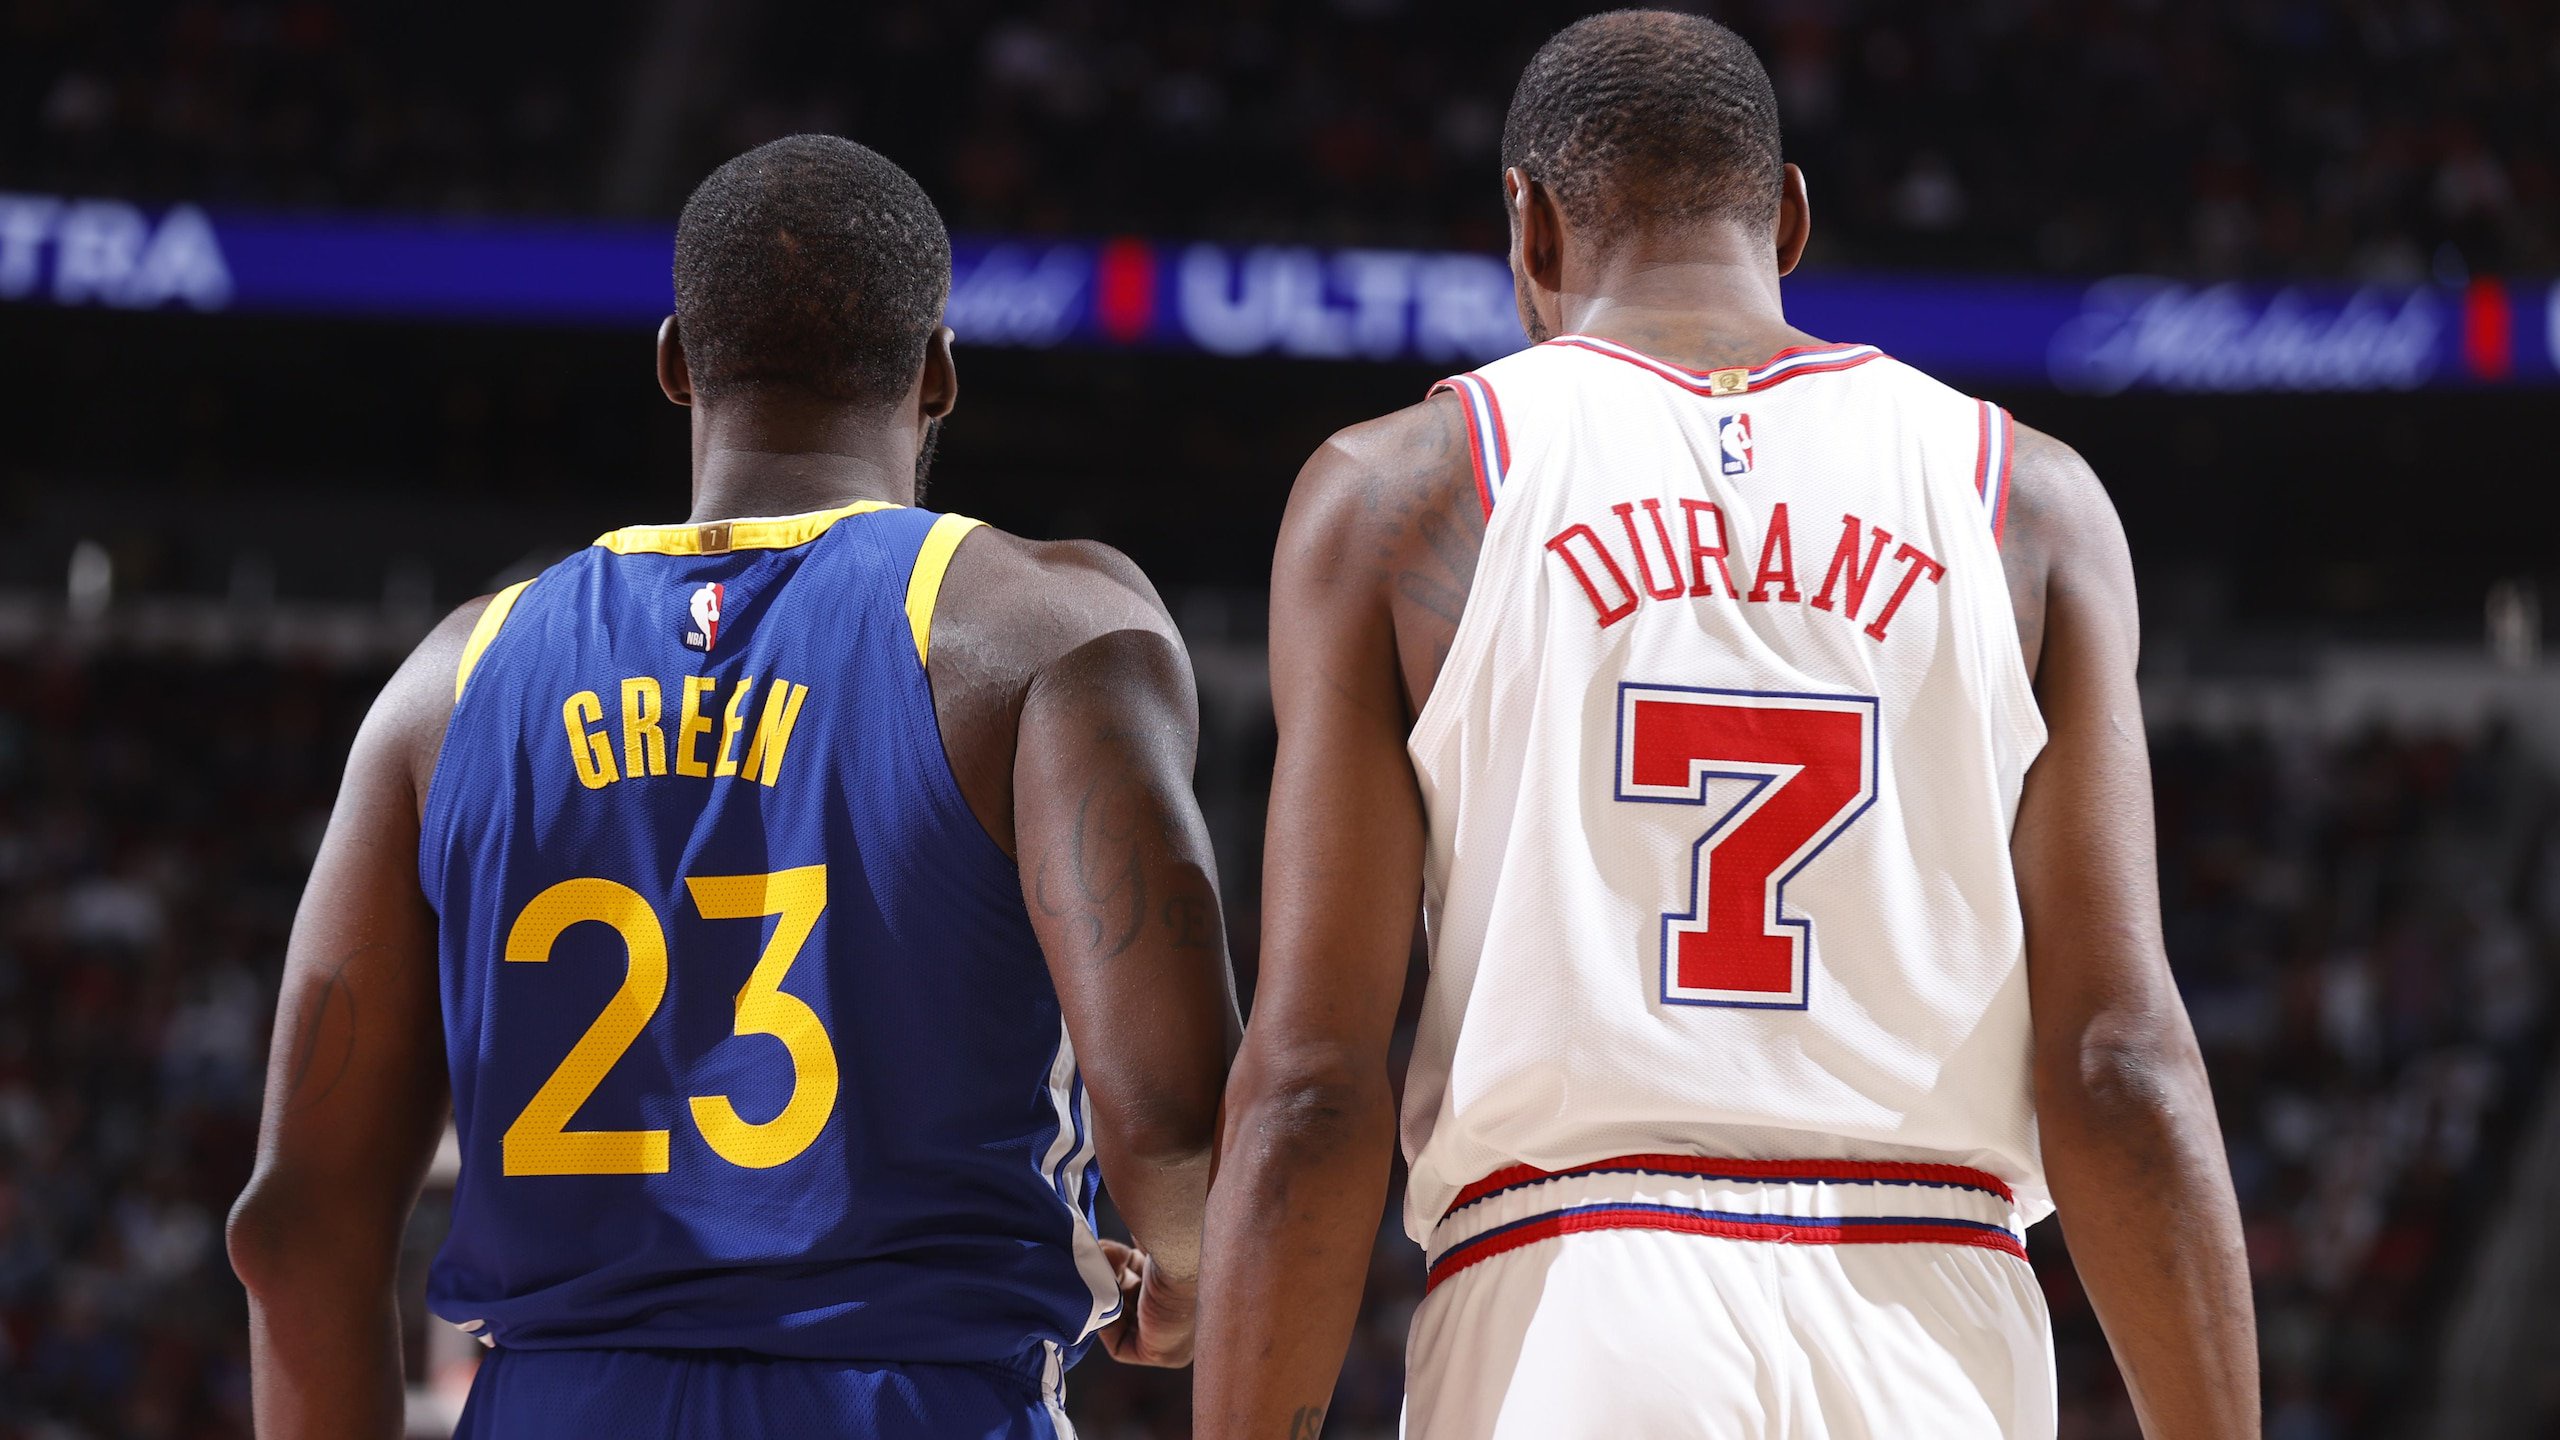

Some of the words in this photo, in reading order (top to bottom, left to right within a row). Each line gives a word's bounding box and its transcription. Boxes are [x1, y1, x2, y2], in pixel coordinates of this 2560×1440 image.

[687, 631, 704, 646] NBA
[1545, 497, 1946, 643] DURANT
[562, 675, 809, 790] GREEN
[1614, 681, 1879, 1010] 7
[503, 863, 839, 1176] 23
